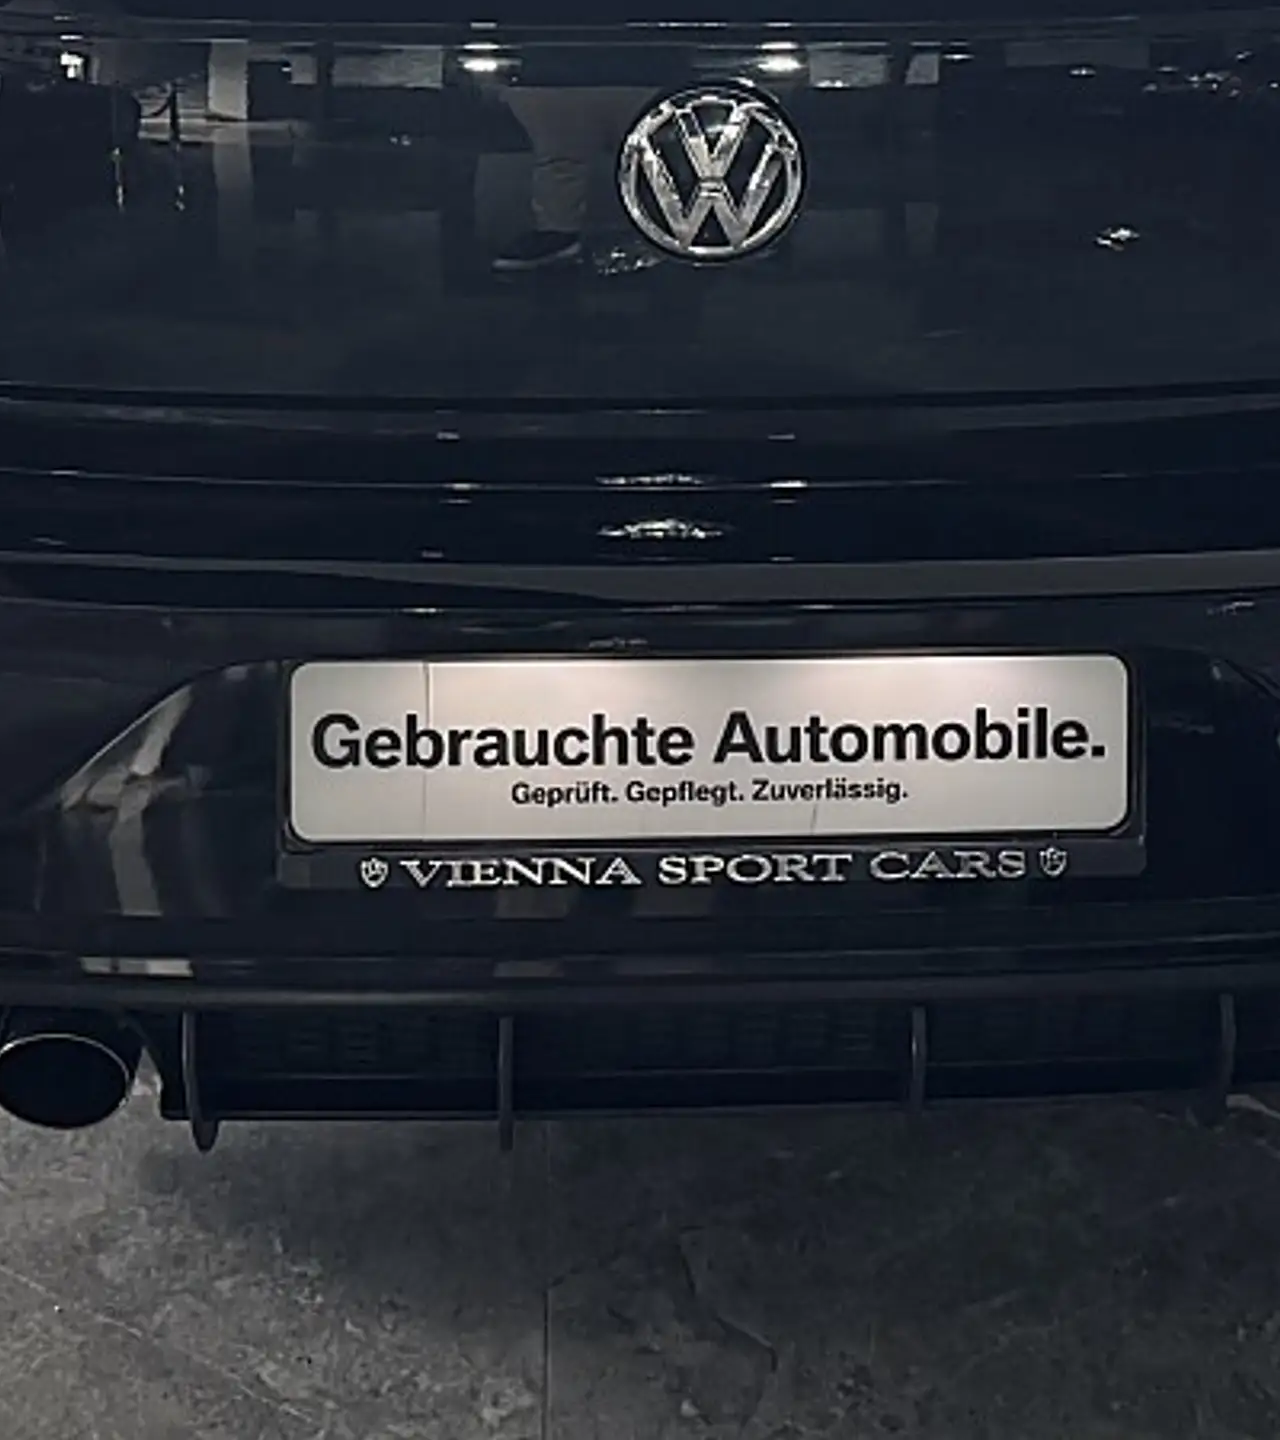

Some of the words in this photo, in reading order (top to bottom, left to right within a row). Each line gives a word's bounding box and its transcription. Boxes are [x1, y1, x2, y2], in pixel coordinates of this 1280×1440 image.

[623, 91, 800, 256] VW
[311, 712, 695, 768] Gebrauchte
[713, 706, 1106, 764] Automobile.
[511, 780, 618, 808] Geprüft.
[626, 779, 745, 807] Gepflegt.
[752, 777, 909, 804] Zuverlässig.
[400, 856, 643, 889] VIENNA
[658, 853, 853, 886] SPORT
[870, 850, 1026, 880] CARS
